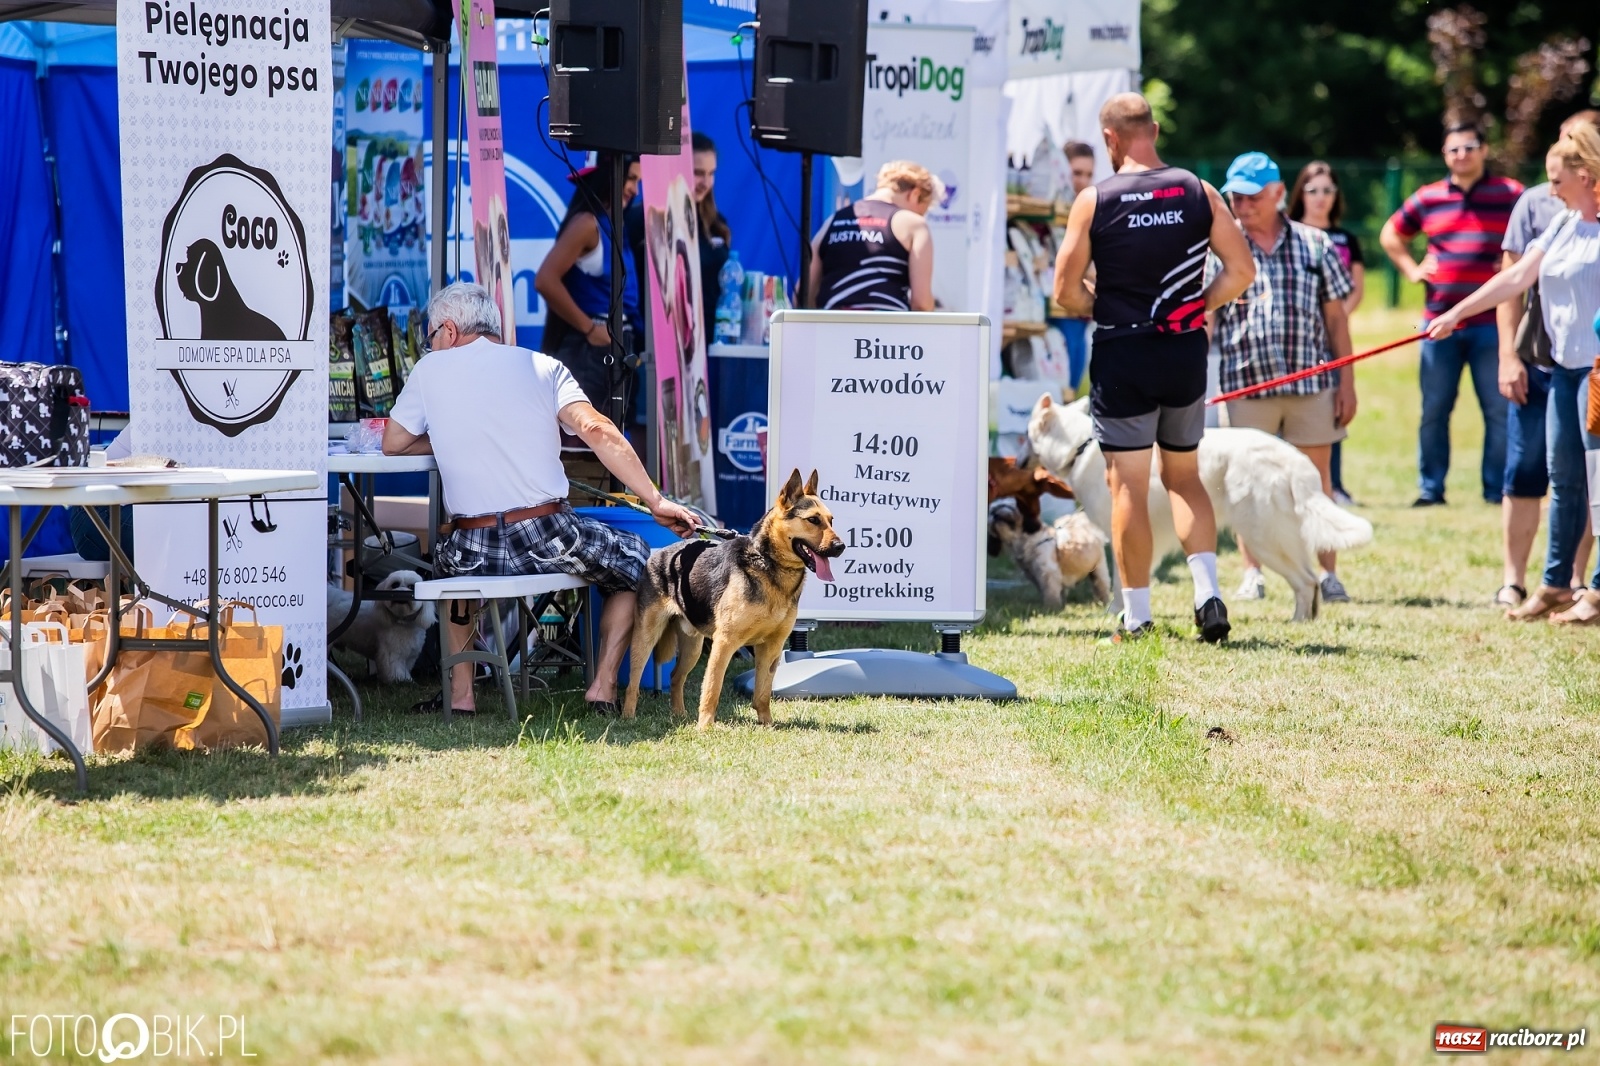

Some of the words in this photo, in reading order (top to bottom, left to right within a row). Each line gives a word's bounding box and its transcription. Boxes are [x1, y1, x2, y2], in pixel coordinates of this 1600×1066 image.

[145, 0, 309, 50] Pielęgnacja
[138, 51, 258, 97] Twojego
[268, 65, 318, 98] psa
[866, 54, 964, 101] TropiDog
[1127, 209, 1184, 228] ZIOMEK
[828, 229, 884, 245] JUSTYNA
[178, 346, 221, 363] DOMOWE
[223, 347, 243, 363] SPA
[246, 347, 267, 363] DLA
[269, 347, 291, 363] PSA
[854, 338, 924, 361] Biuro
[831, 373, 946, 395] zawodów
[852, 432, 919, 457] 14:00
[854, 464, 911, 483] Marsz
[819, 486, 941, 514] charytatywny
[846, 527, 913, 549] 15:00
[183, 568, 207, 586] +48
[234, 566, 258, 584] 802
[261, 565, 287, 583] 546
[844, 559, 915, 578] Zawody
[823, 583, 935, 602] Dogtrekking
